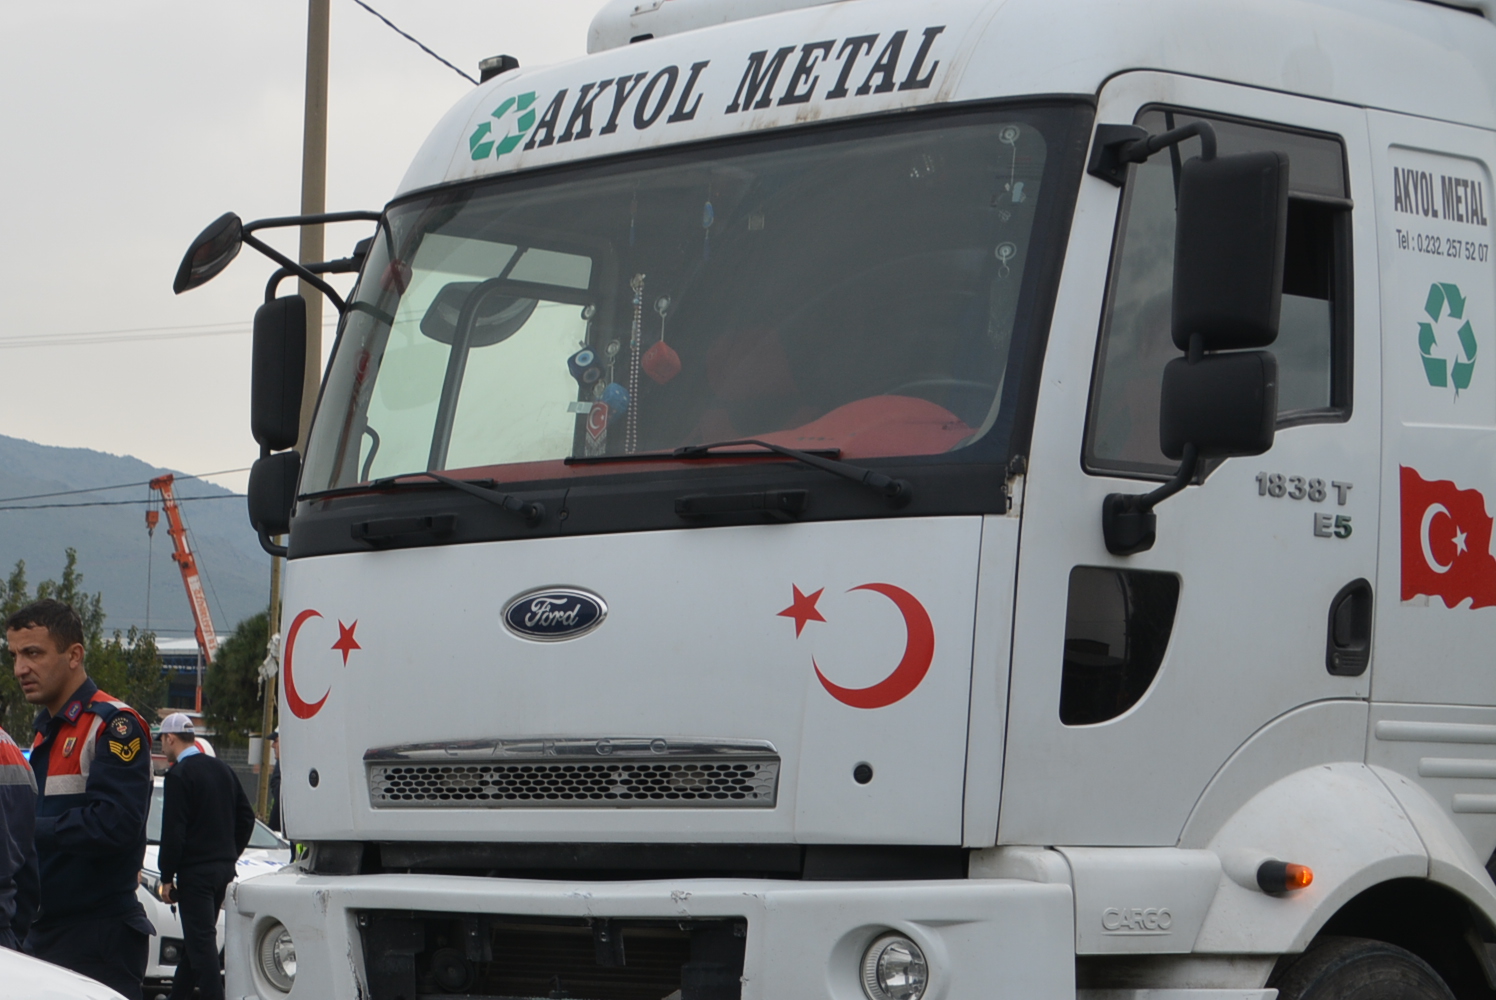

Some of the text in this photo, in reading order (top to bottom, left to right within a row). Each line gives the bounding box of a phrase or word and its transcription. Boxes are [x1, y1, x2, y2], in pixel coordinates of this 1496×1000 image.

[522, 25, 946, 151] AKYOL METAL
[1393, 166, 1488, 227] AKYOL METAL
[1395, 229, 1410, 251] Tel
[1446, 238, 1462, 259] 257
[1464, 242, 1477, 261] 52
[1478, 244, 1489, 262] 07
[1255, 471, 1353, 506] 1838 T
[1313, 512, 1353, 539] E5
[524, 598, 582, 627] Ford
[443, 737, 668, 757] CARGO
[1102, 907, 1171, 931] CARGO
